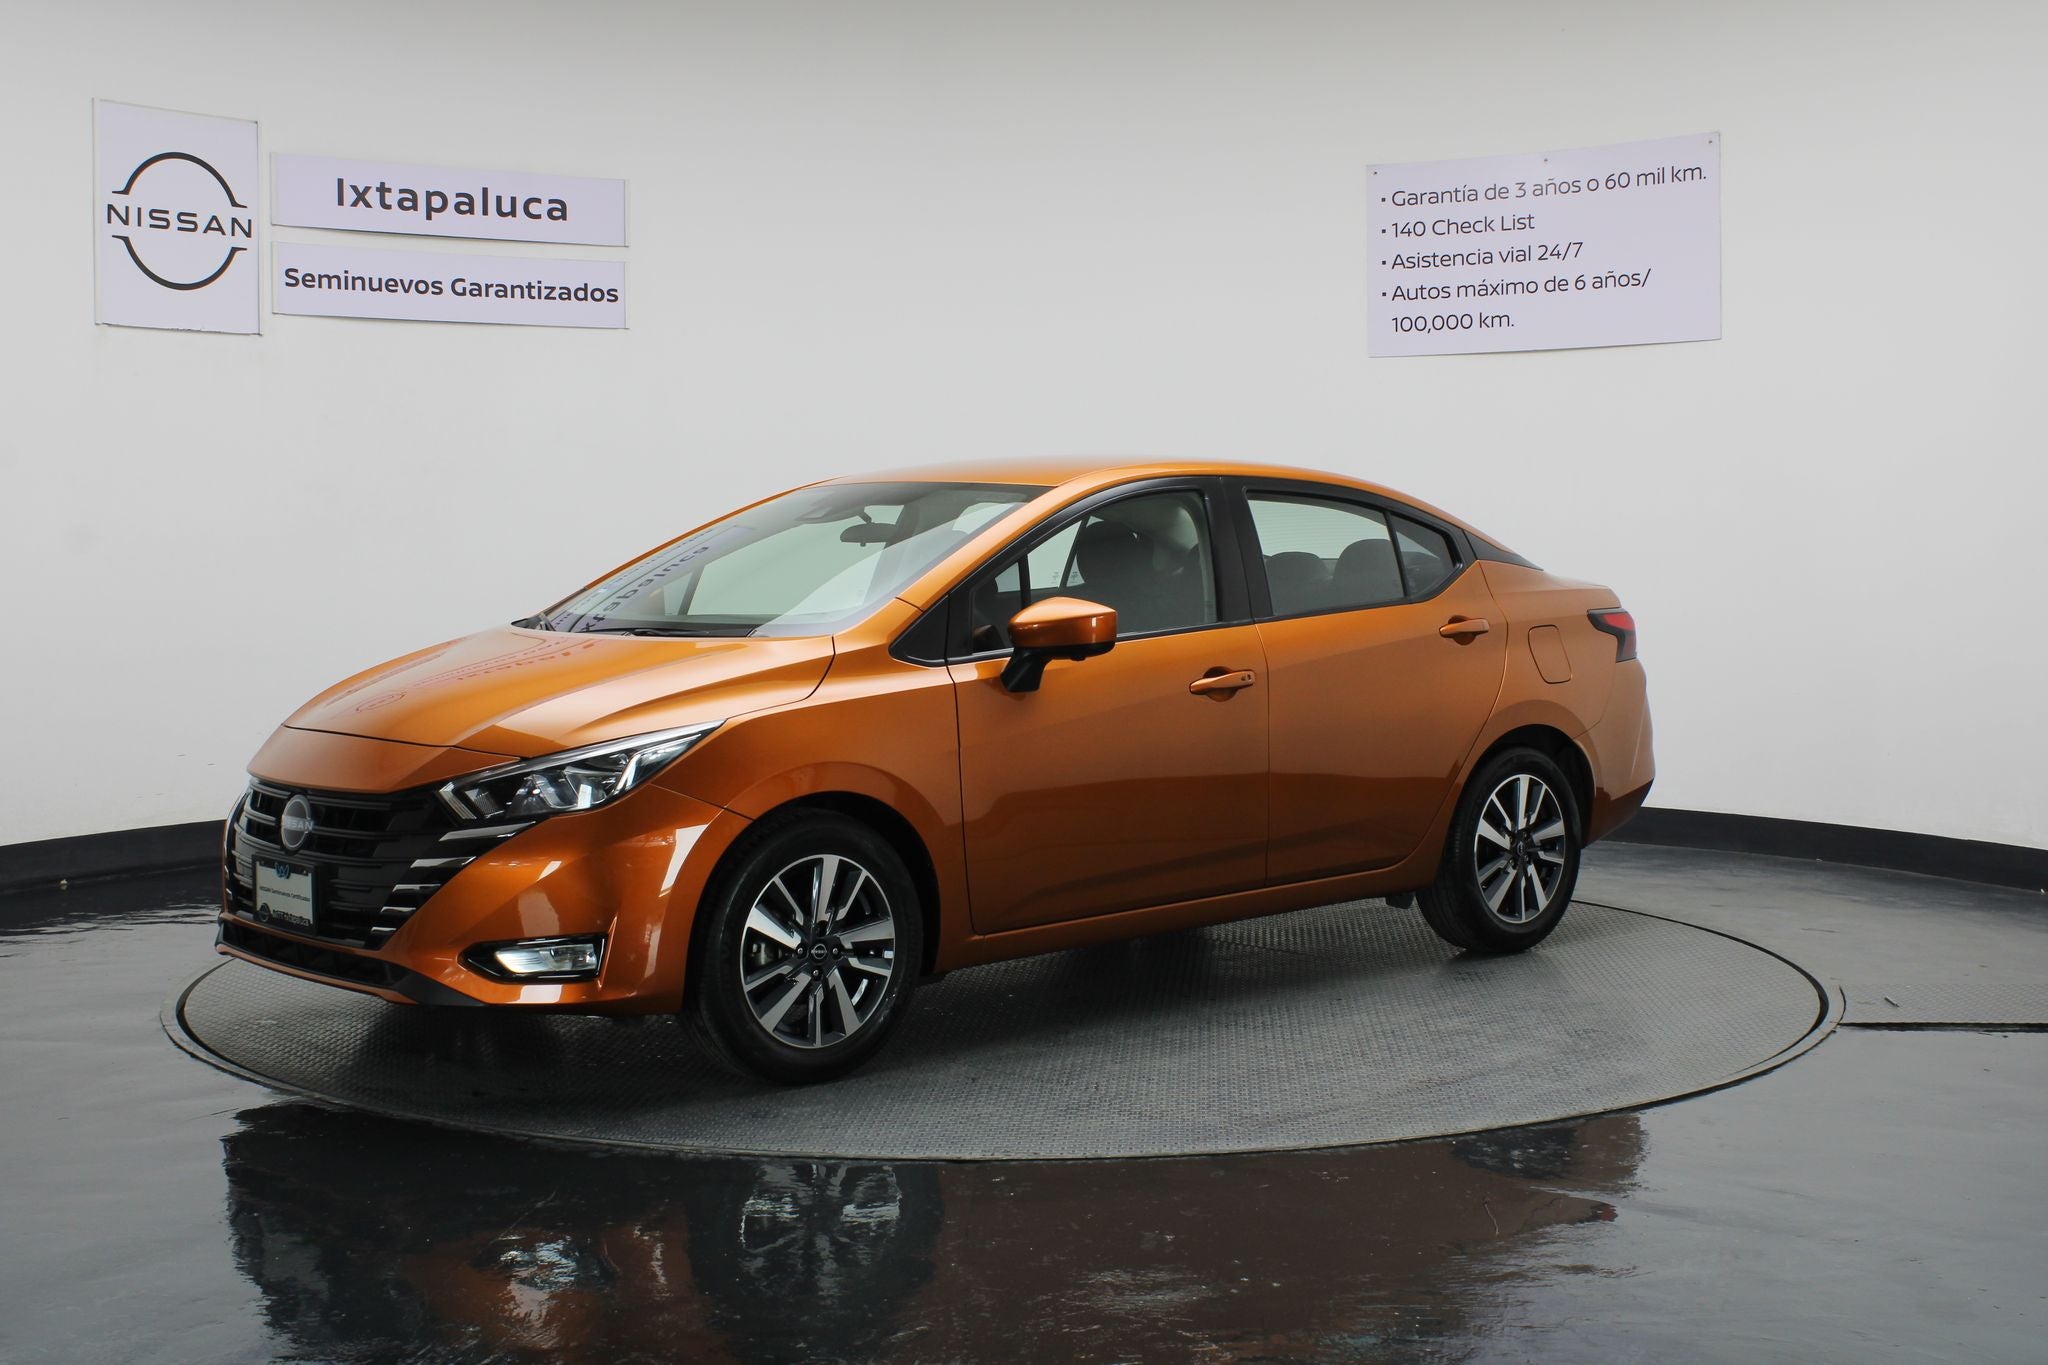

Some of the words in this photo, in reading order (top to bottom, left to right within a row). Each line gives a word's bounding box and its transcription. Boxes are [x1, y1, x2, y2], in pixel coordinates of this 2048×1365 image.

[336, 177, 568, 222] Ixtapaluca
[1391, 184, 1479, 207] Garantía
[1484, 183, 1510, 201] de
[1515, 181, 1527, 199] 3
[1532, 177, 1582, 197] años
[1586, 178, 1600, 192] o
[1604, 171, 1631, 191] 60
[1636, 166, 1665, 187] mil
[1671, 165, 1707, 184] km.
[106, 203, 253, 239] NISSAN
[1391, 221, 1427, 239] 140
[1431, 215, 1496, 236] Check
[1500, 213, 1536, 232] List
[1391, 248, 1494, 270] Asistencia
[1498, 244, 1532, 264] vial
[1537, 241, 1584, 262] 24/7
[284, 267, 444, 297] Seminuevos
[450, 277, 619, 304] Garantizados
[1391, 284, 1452, 302] Autos
[1456, 278, 1539, 299] máximo
[1543, 275, 1569, 293] de
[1574, 273, 1587, 291] 6
[1591, 267, 1652, 290] años/
[1391, 313, 1474, 335] 100,000
[1479, 311, 1515, 329] km.
